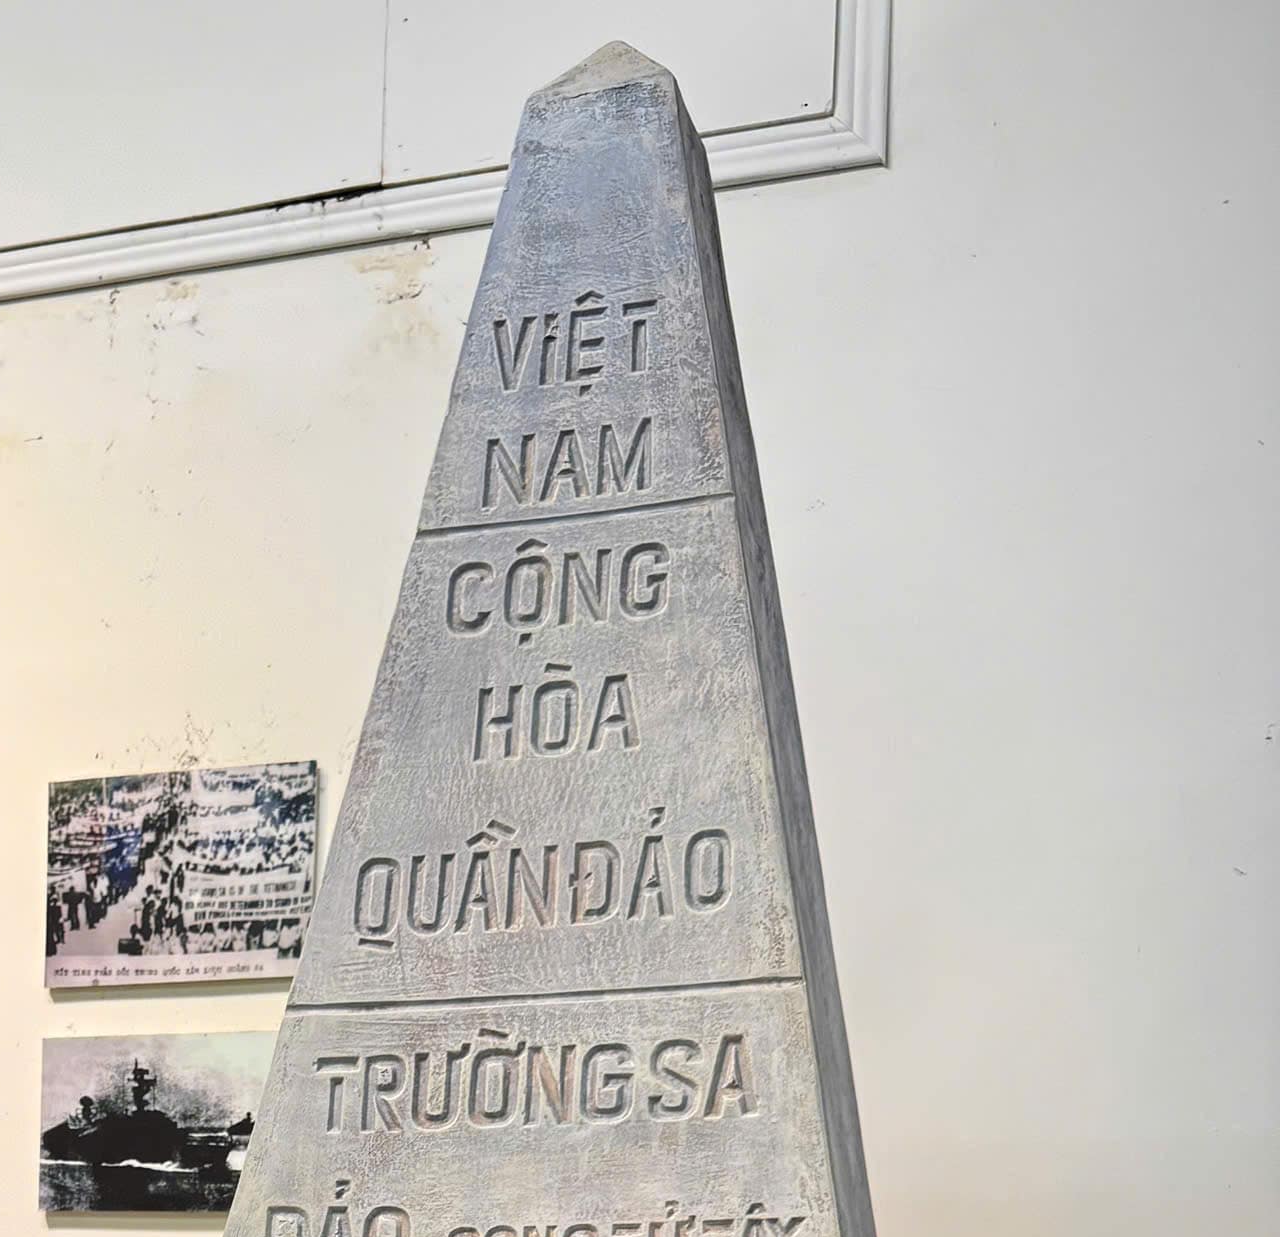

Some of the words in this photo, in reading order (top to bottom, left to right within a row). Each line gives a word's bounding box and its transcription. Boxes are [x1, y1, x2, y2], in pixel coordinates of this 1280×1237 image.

[493, 290, 658, 396] VIỆT
[482, 417, 654, 512] NAM
[446, 537, 670, 646] CỘNG
[474, 663, 641, 762] HÒA
[354, 819, 559, 950] QUẦN
[569, 807, 733, 926] ĐẢO
[314, 1027, 635, 1136] TRƯỜNG
[648, 1032, 759, 1121] SA
